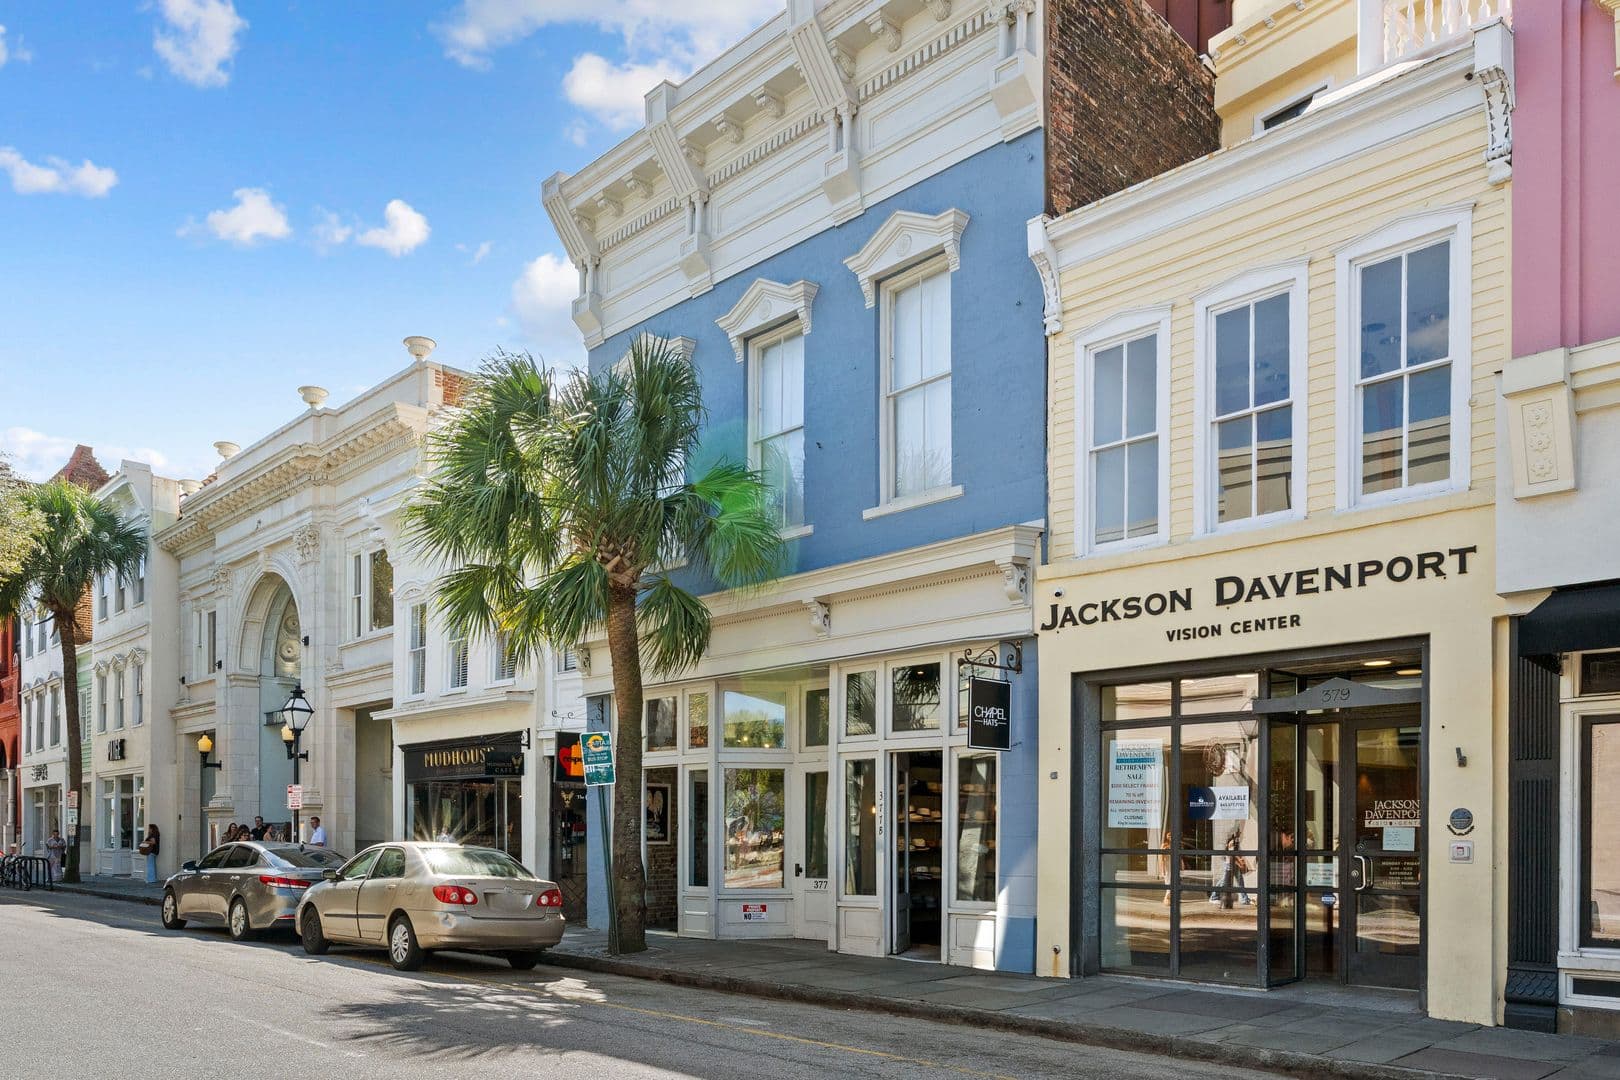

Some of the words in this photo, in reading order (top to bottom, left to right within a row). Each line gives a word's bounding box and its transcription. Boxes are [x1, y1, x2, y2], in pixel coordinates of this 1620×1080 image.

[1215, 545, 1478, 607] DAVENPORT
[1166, 624, 1222, 643] VISION
[1230, 614, 1302, 634] CENTER
[1322, 687, 1351, 703] 379
[974, 705, 1007, 721] CHAPEL
[983, 718, 998, 727] HATS
[424, 746, 495, 768] MUDHOUS
[1374, 799, 1420, 811] JACKSON
[813, 880, 828, 890] 377
[744, 912, 752, 920] NO
